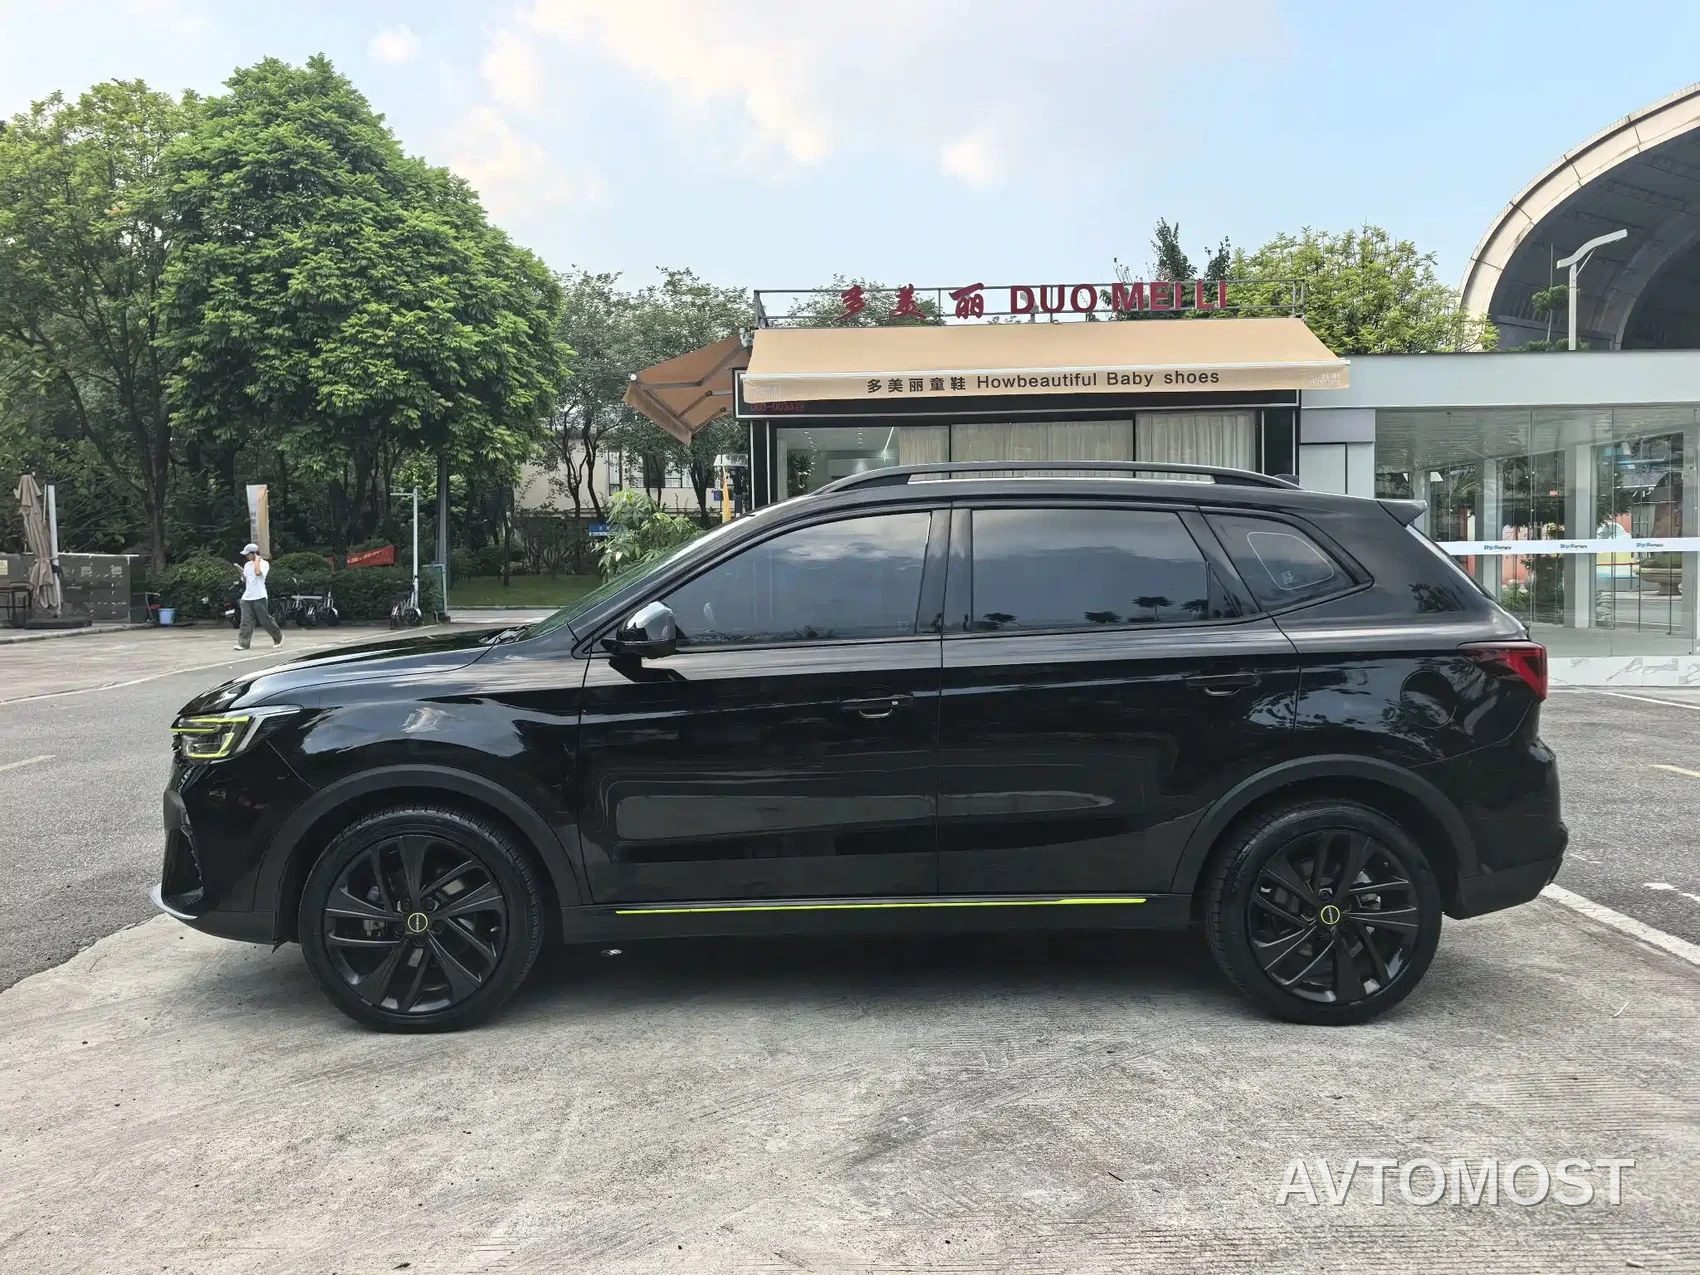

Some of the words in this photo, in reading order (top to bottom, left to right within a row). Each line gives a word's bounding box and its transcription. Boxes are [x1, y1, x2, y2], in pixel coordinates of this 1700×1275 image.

[1010, 284, 1098, 314] DUO
[1112, 281, 1182, 311] MEI
[867, 377, 966, 394] 多美丽童鞋
[977, 373, 1097, 389] Howbeautiful
[1107, 372, 1153, 387] Baby
[1164, 370, 1220, 384] shoes
